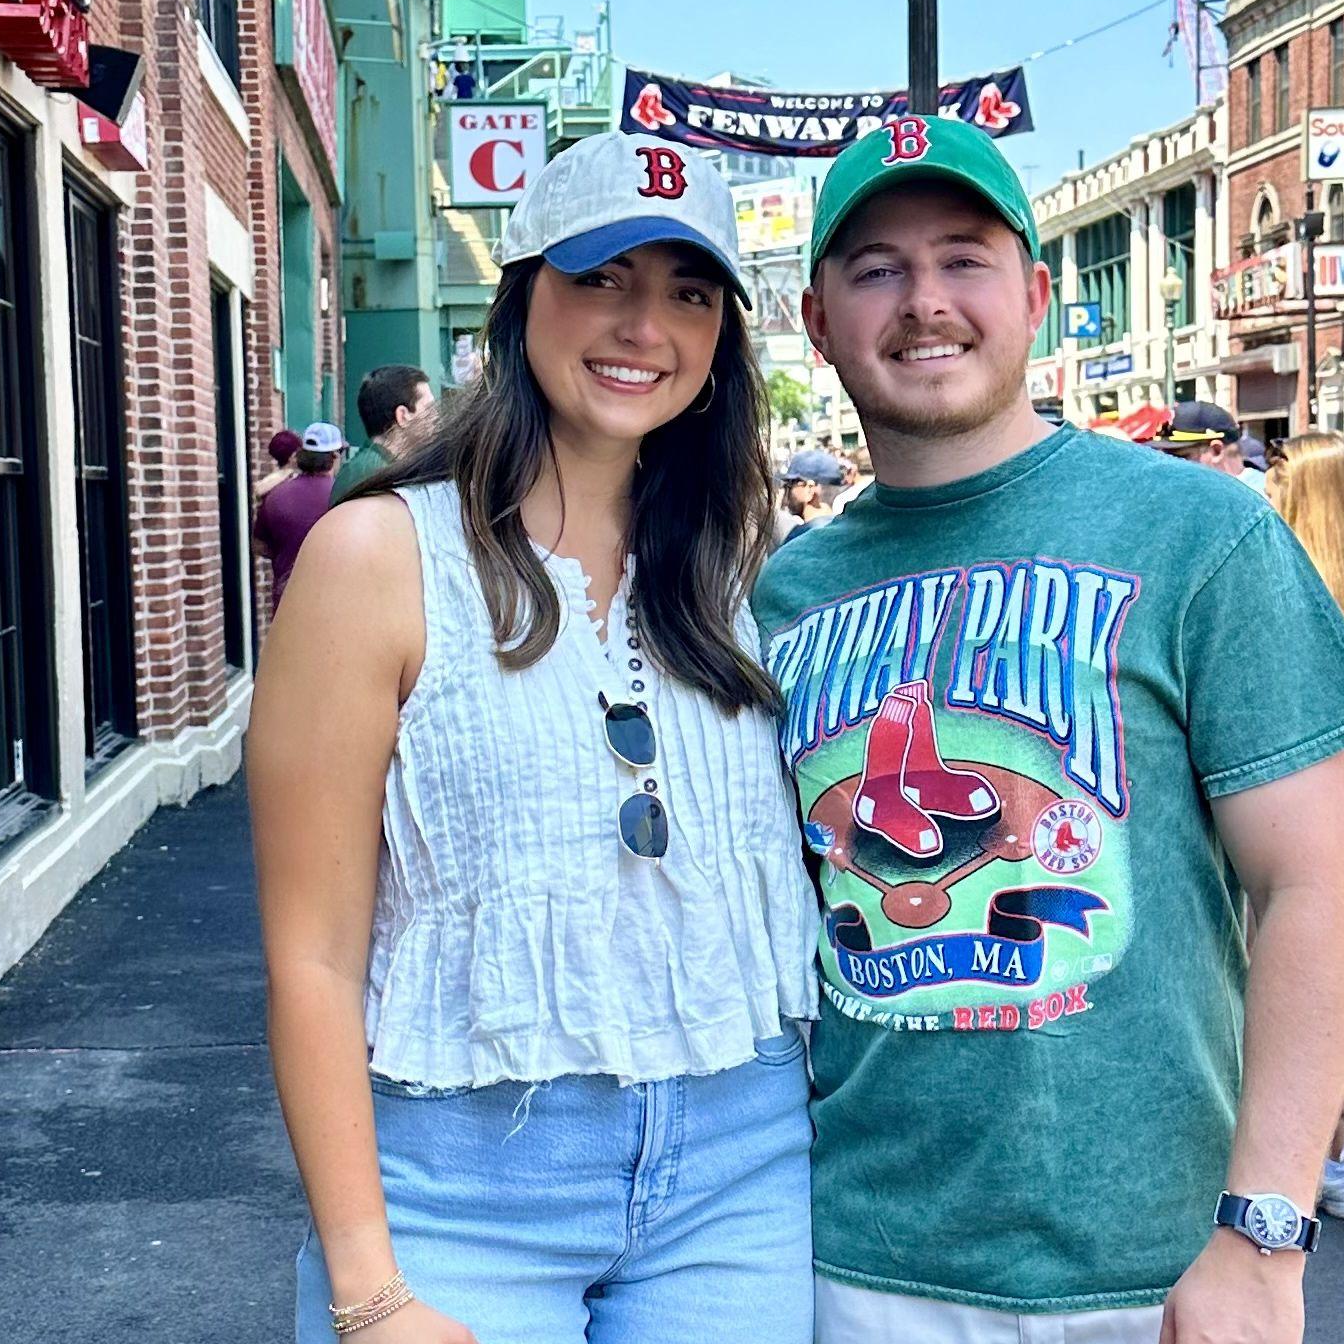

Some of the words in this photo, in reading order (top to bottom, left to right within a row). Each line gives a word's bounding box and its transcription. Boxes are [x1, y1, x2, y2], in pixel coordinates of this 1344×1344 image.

[770, 95, 854, 110] WELCOME
[861, 95, 884, 108] TO
[459, 113, 538, 131] GATE
[687, 104, 850, 141] FENWAY
[881, 116, 933, 164] B
[469, 139, 525, 192] C
[635, 147, 689, 200] B
[1068, 306, 1090, 335] P
[948, 561, 1137, 814] PARK
[1040, 804, 1094, 830] BOSTON
[1040, 848, 1066, 871] RED
[1071, 843, 1096, 869] SOX
[847, 942, 954, 990] BOSTON,
[970, 940, 1027, 980] MA
[892, 1014, 940, 1032] THE
[952, 1004, 1021, 1032] RED
